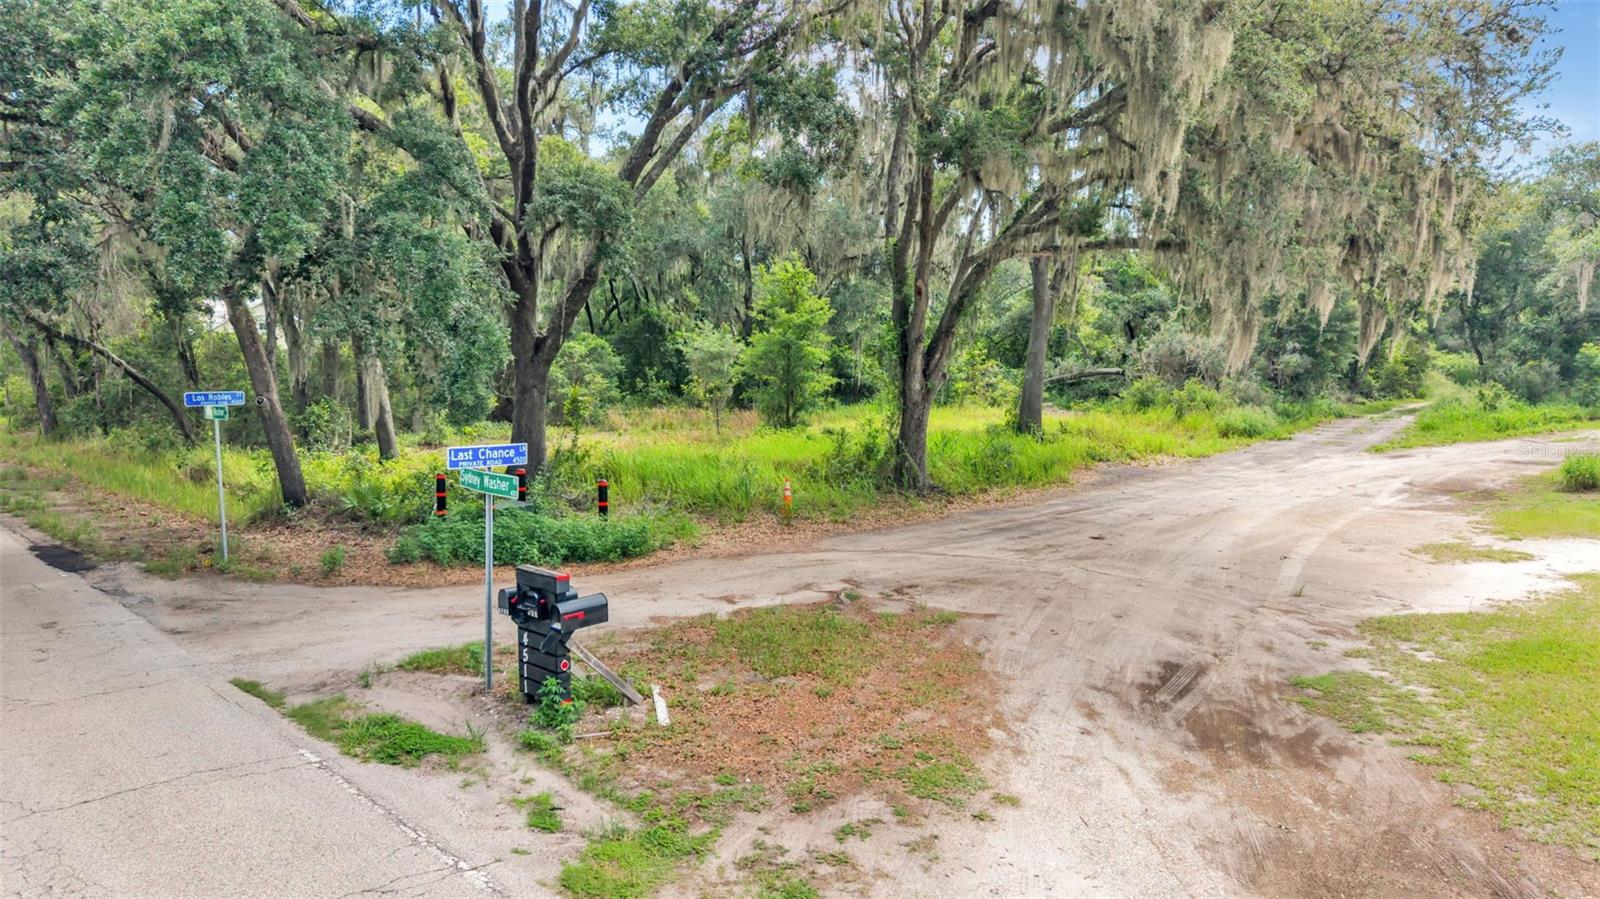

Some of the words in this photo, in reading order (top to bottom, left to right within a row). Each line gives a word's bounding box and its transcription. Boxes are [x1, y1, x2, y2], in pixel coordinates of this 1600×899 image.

[192, 394, 205, 402] Los
[208, 393, 232, 401] Robles
[451, 449, 473, 461] Last
[479, 448, 515, 459] Chance
[458, 460, 483, 468] PRIVATE
[461, 469, 481, 488] Sydney
[483, 475, 510, 491] Washer
